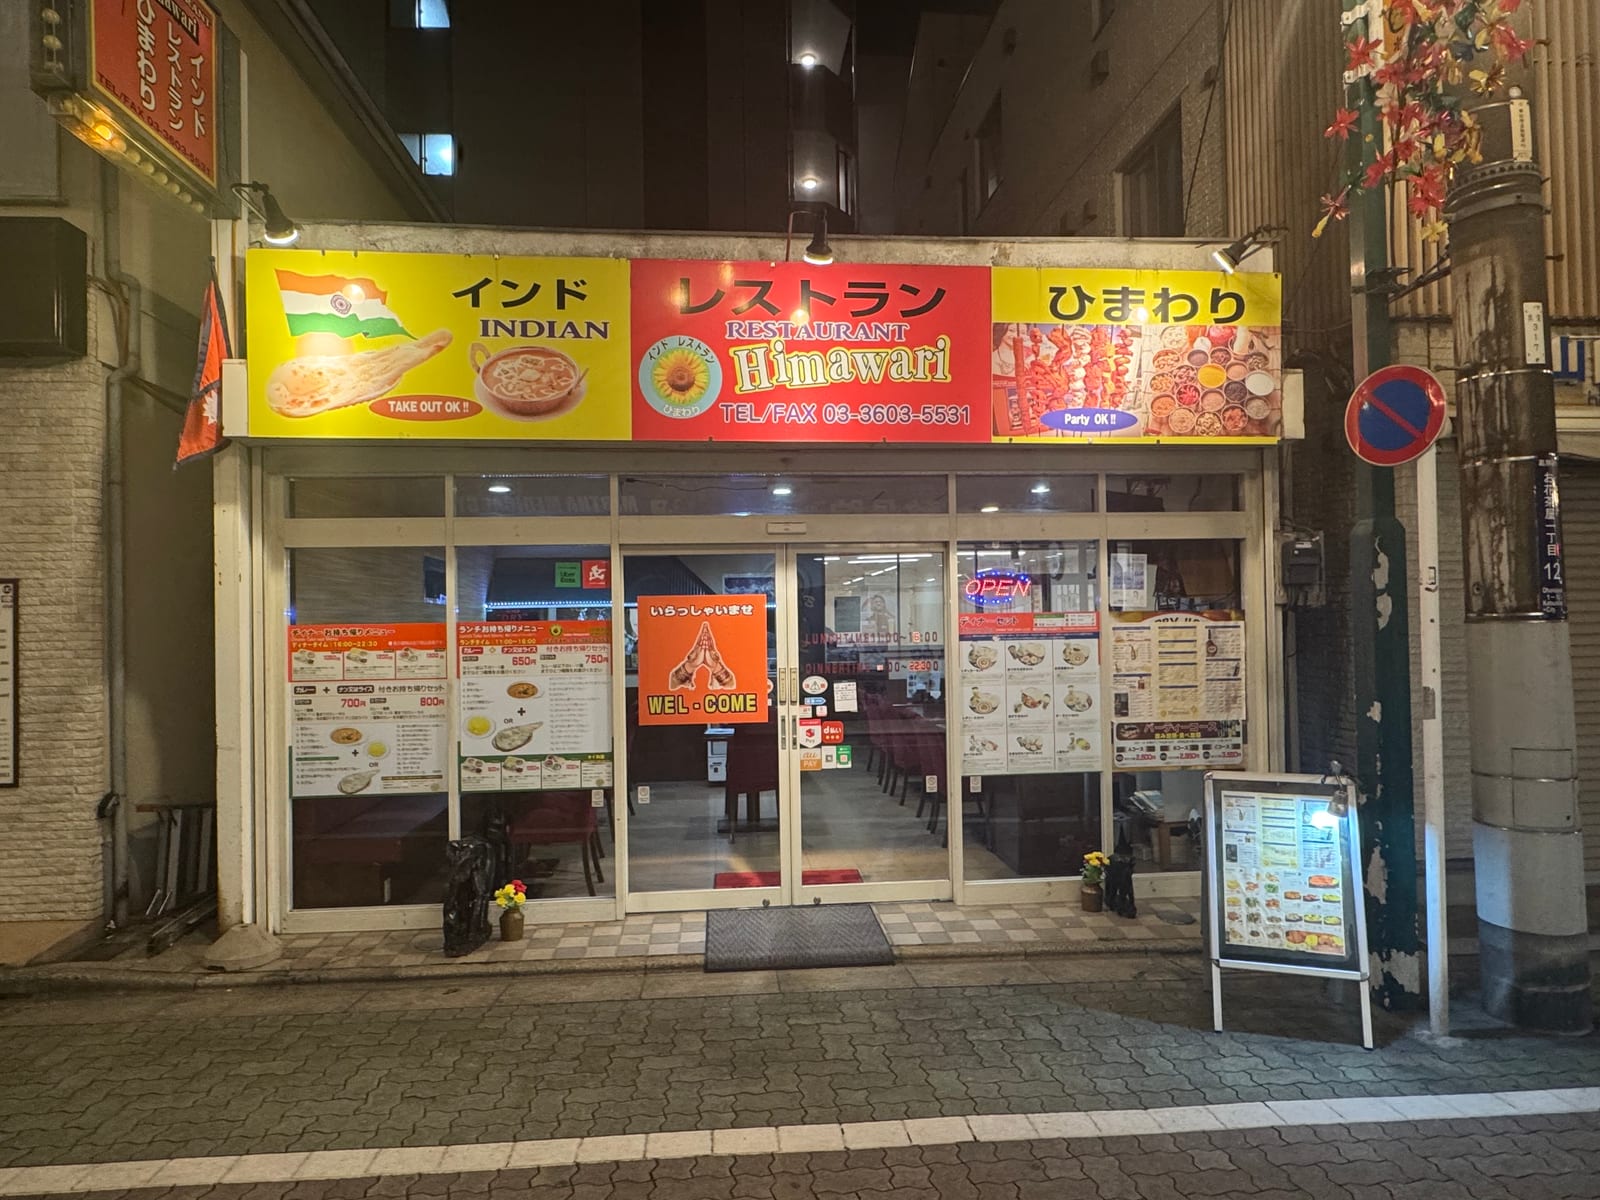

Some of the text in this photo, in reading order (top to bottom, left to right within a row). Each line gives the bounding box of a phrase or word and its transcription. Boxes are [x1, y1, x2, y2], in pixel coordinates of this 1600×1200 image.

[136, 0, 157, 111] ひまわり
[167, 21, 183, 130] レストラン
[191, 55, 206, 138] インド
[452, 277, 588, 310] インド
[679, 277, 947, 318] レストラン
[1048, 285, 1246, 324] ひまわり
[480, 319, 610, 340] INDIAN
[726, 322, 909, 341] RESTAURANT
[648, 336, 715, 364] インド レストラン
[733, 338, 951, 392] Himawari
[388, 401, 418, 413] TAKE
[419, 401, 443, 413] OUT
[663, 404, 700, 417] ひまわり
[720, 404, 971, 425] TEL/FAX 03-3603-5531
[1064, 413, 1090, 426] Party
[1543, 561, 1562, 580] 12
[965, 578, 1032, 598] OPEN
[650, 604, 754, 617] いらっしゃいませ
